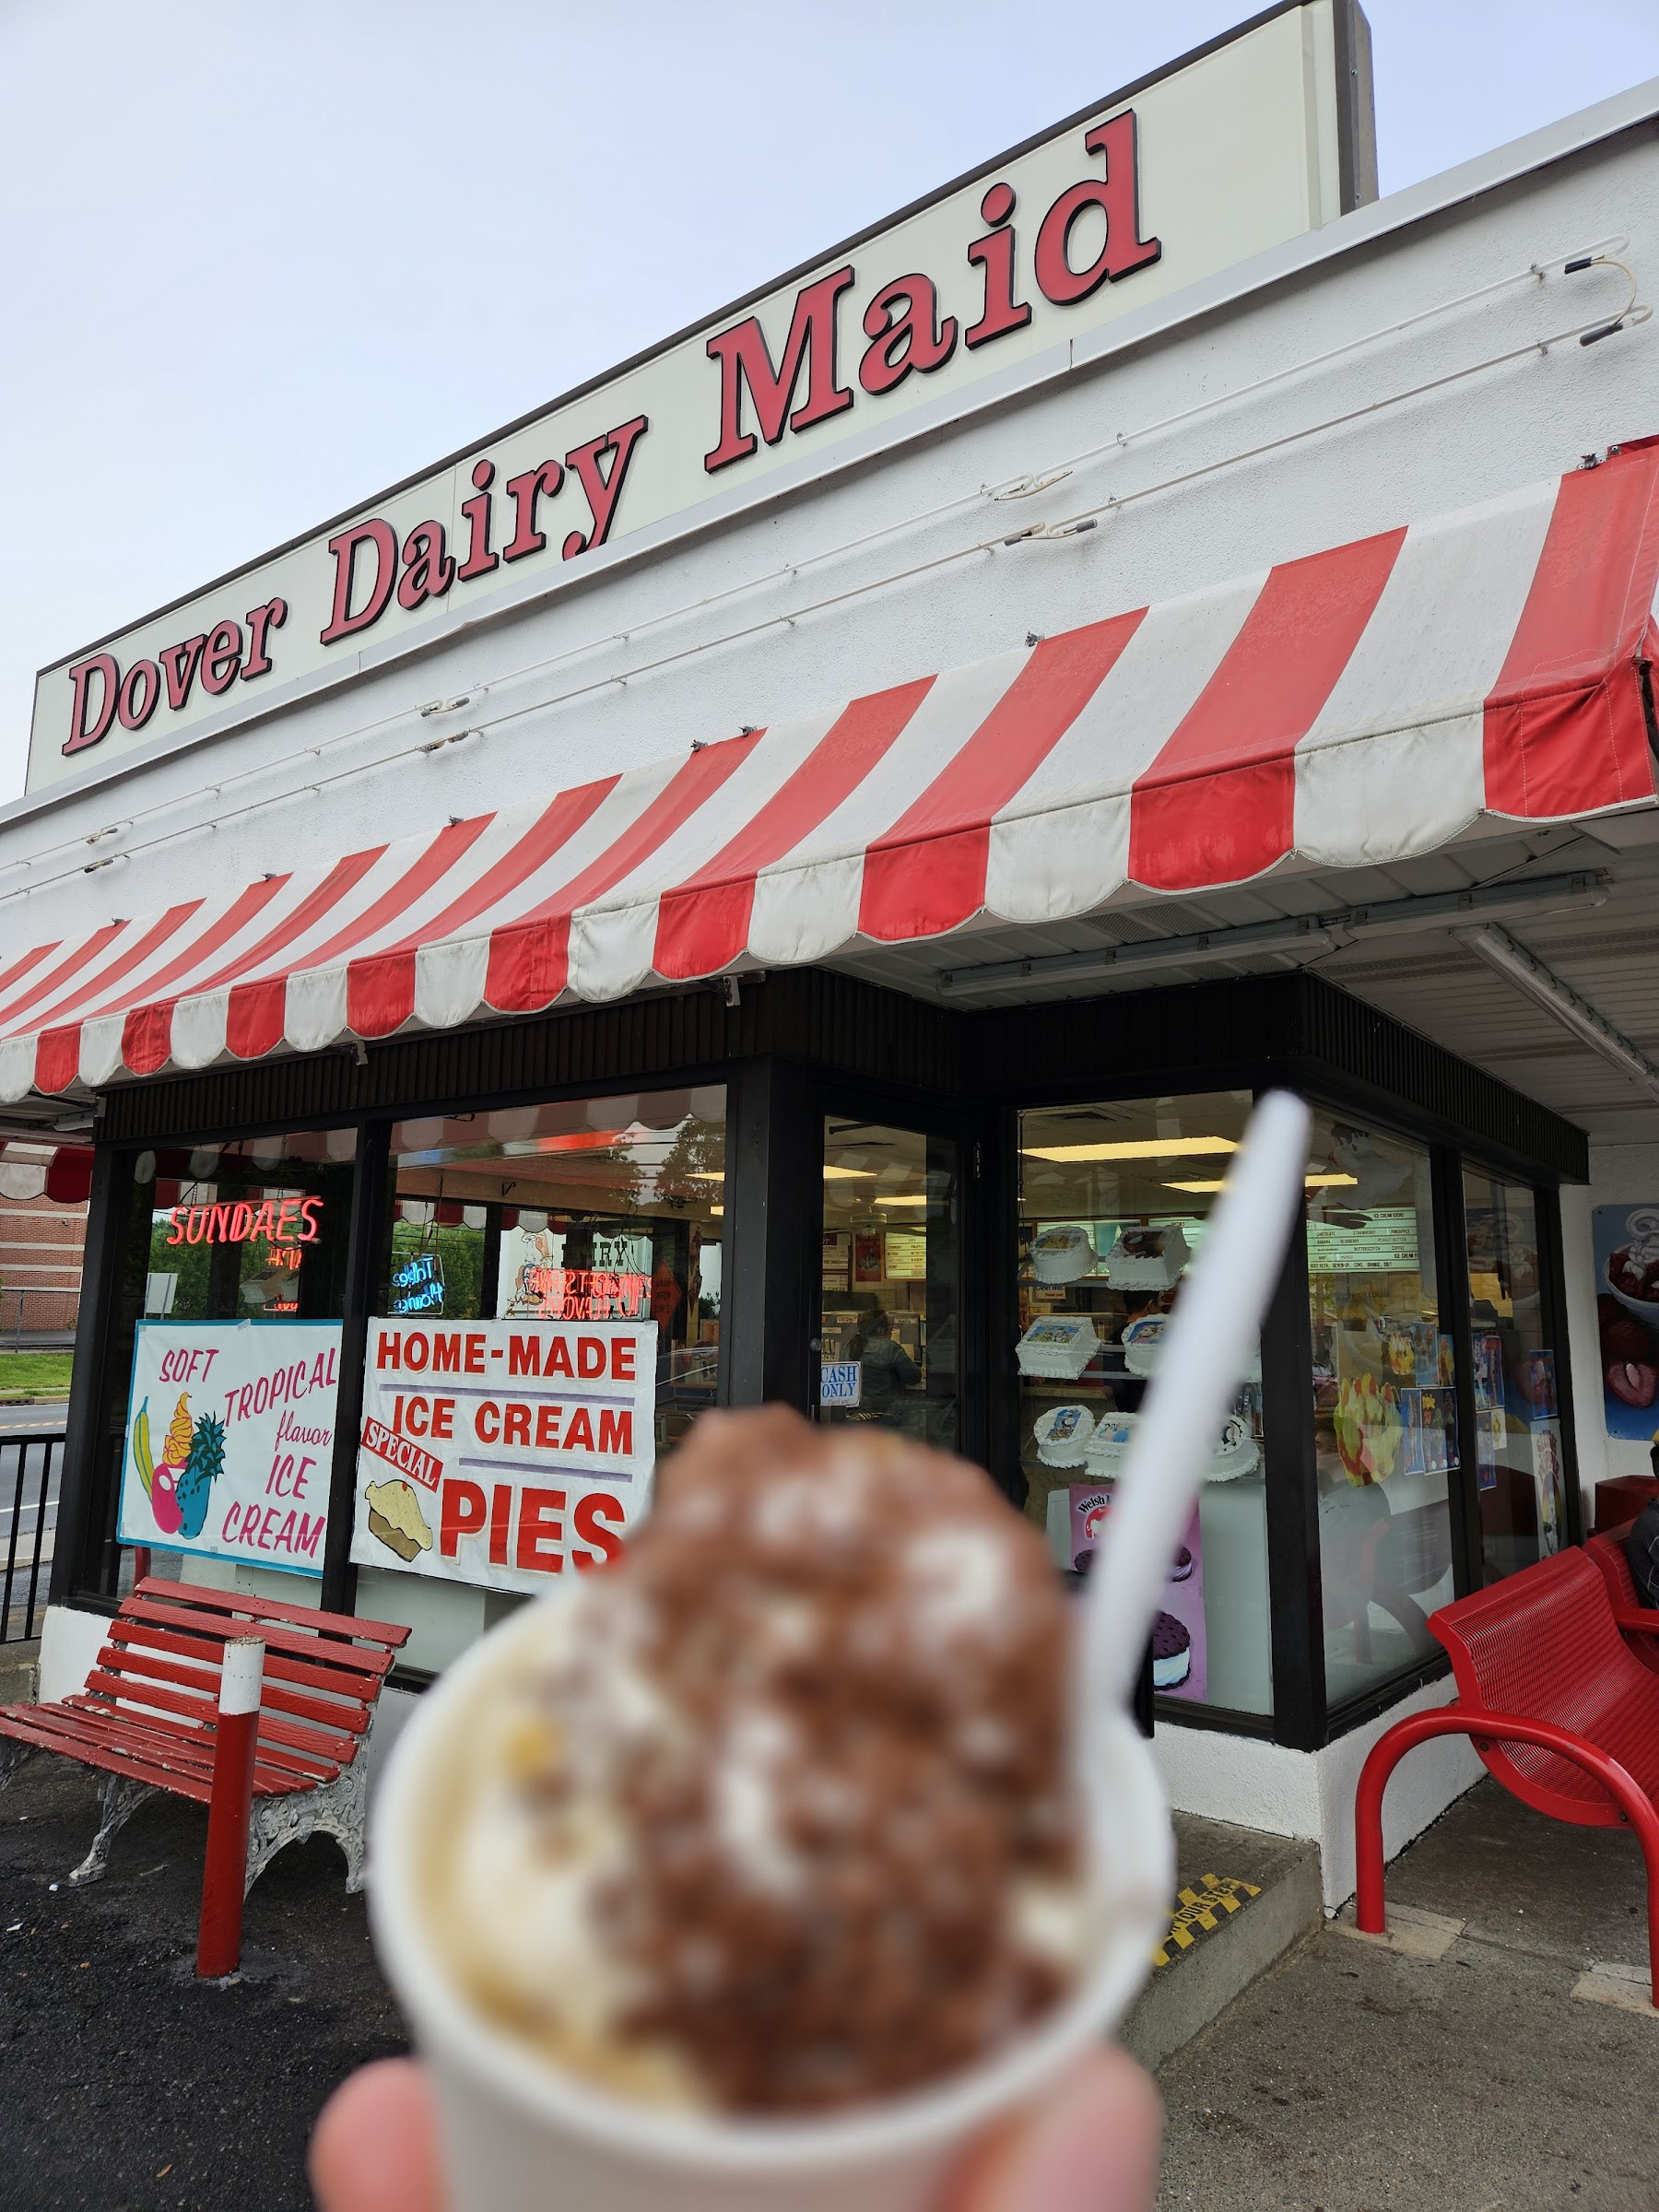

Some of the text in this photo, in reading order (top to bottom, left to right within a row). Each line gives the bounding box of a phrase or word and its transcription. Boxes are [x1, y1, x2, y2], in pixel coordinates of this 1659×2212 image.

[62, 108, 1161, 757] Dover Dairy Maid
[167, 1199, 324, 1244] SUNDAES
[159, 1348, 219, 1384] SOFT
[377, 1332, 637, 1381] HOME-MADE
[820, 1366, 857, 1382] CASH
[224, 1347, 337, 1427] TROPICAL
[822, 1382, 856, 1398] ONLY
[274, 1409, 332, 1452] flavor
[393, 1395, 633, 1455] ICE CREAM
[265, 1454, 316, 1500] ICE
[366, 1421, 438, 1487] SPECIAL
[440, 1478, 626, 1573] PIES
[1077, 1495, 1105, 1513] Welsh
[222, 1503, 326, 1559] CREAM
[1176, 1883, 1233, 1924] YOUR STEP
